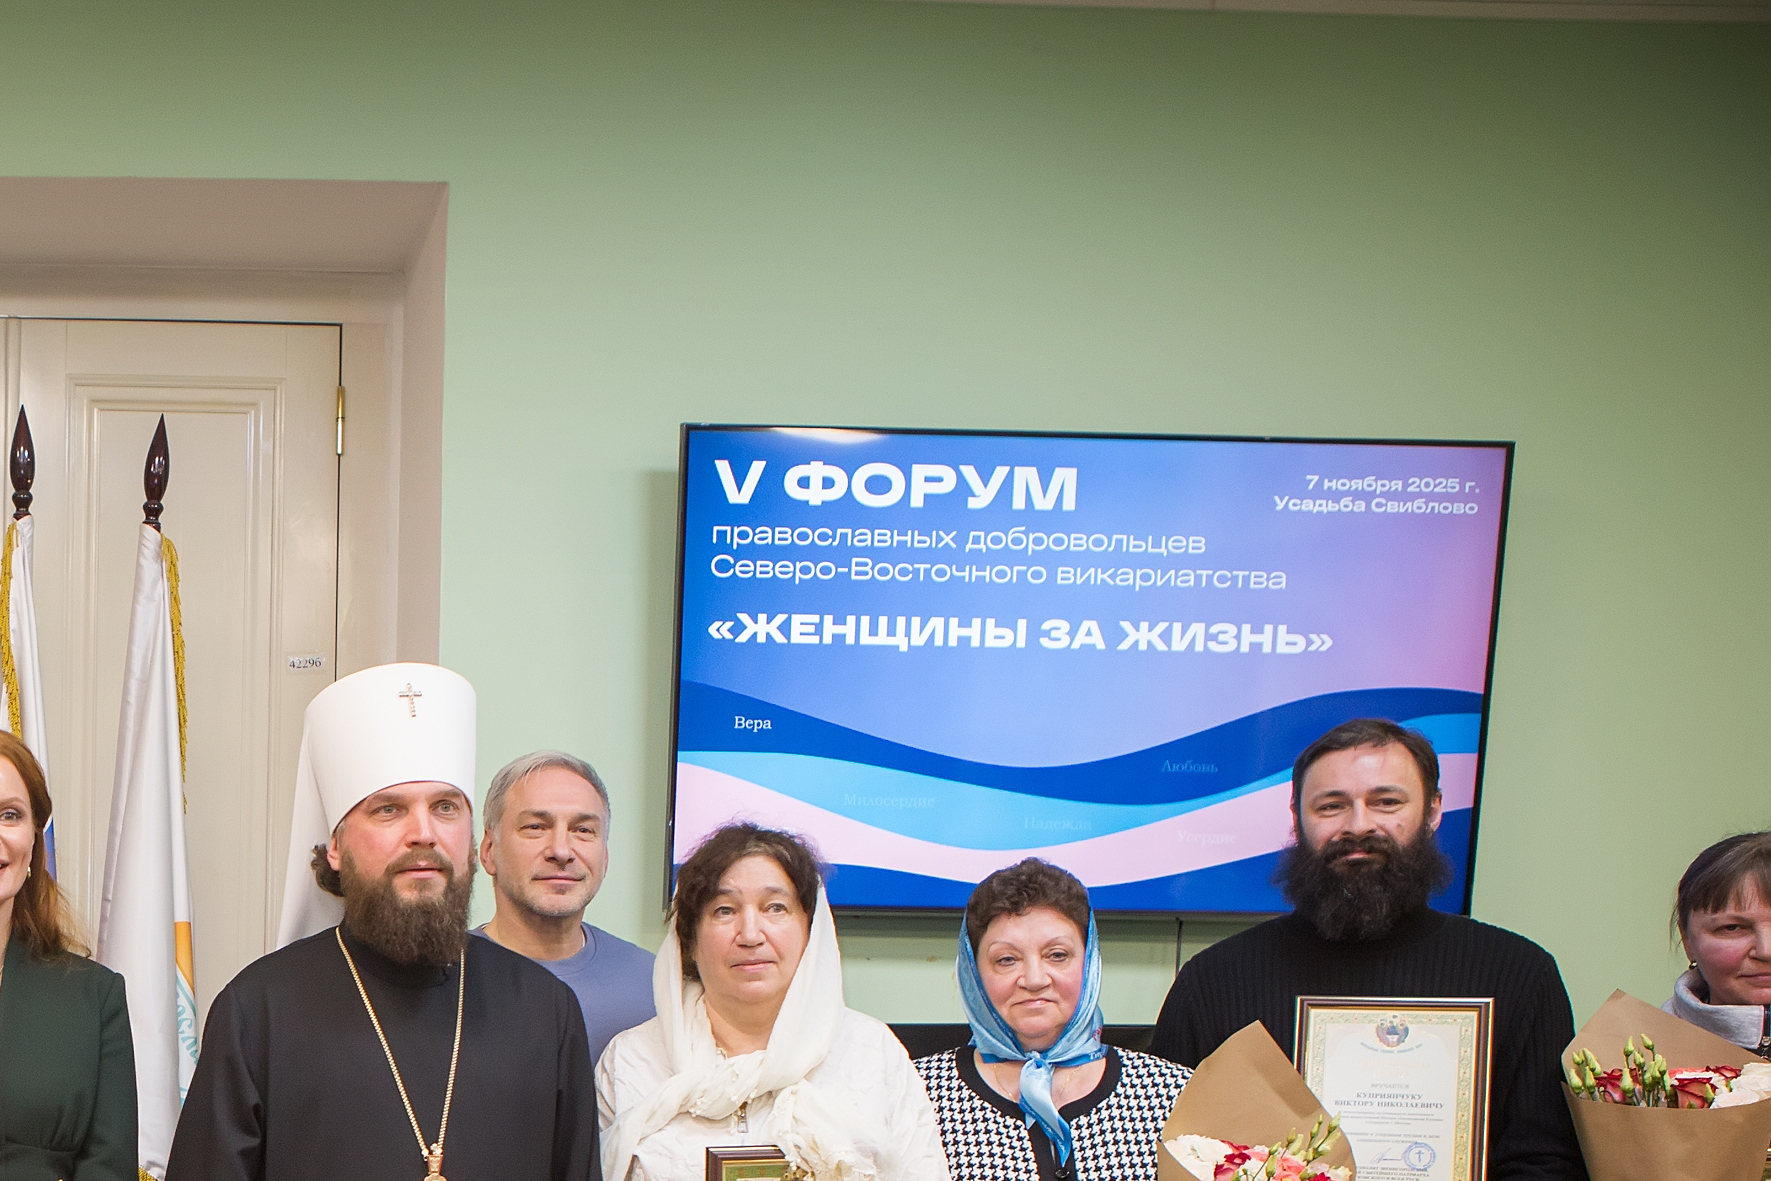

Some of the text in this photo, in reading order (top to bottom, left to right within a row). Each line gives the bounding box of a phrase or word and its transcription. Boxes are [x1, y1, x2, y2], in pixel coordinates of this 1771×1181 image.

[714, 460, 1078, 511] V ФОРУМ
[1305, 475, 1480, 495] 7 ноября 2025 г.
[1273, 495, 1478, 515] Усадьба Свиблово
[712, 525, 1206, 557] православных добровольцев
[710, 554, 1287, 591] Северо-Восточного викариатства
[707, 612, 1334, 655] «ЖЕНЩИНЫ ЗА ЖИЗНЬ»
[289, 657, 322, 669] 42296
[734, 715, 772, 732] Вера
[1160, 759, 1218, 774] Любовь
[843, 792, 936, 811] Милосердие
